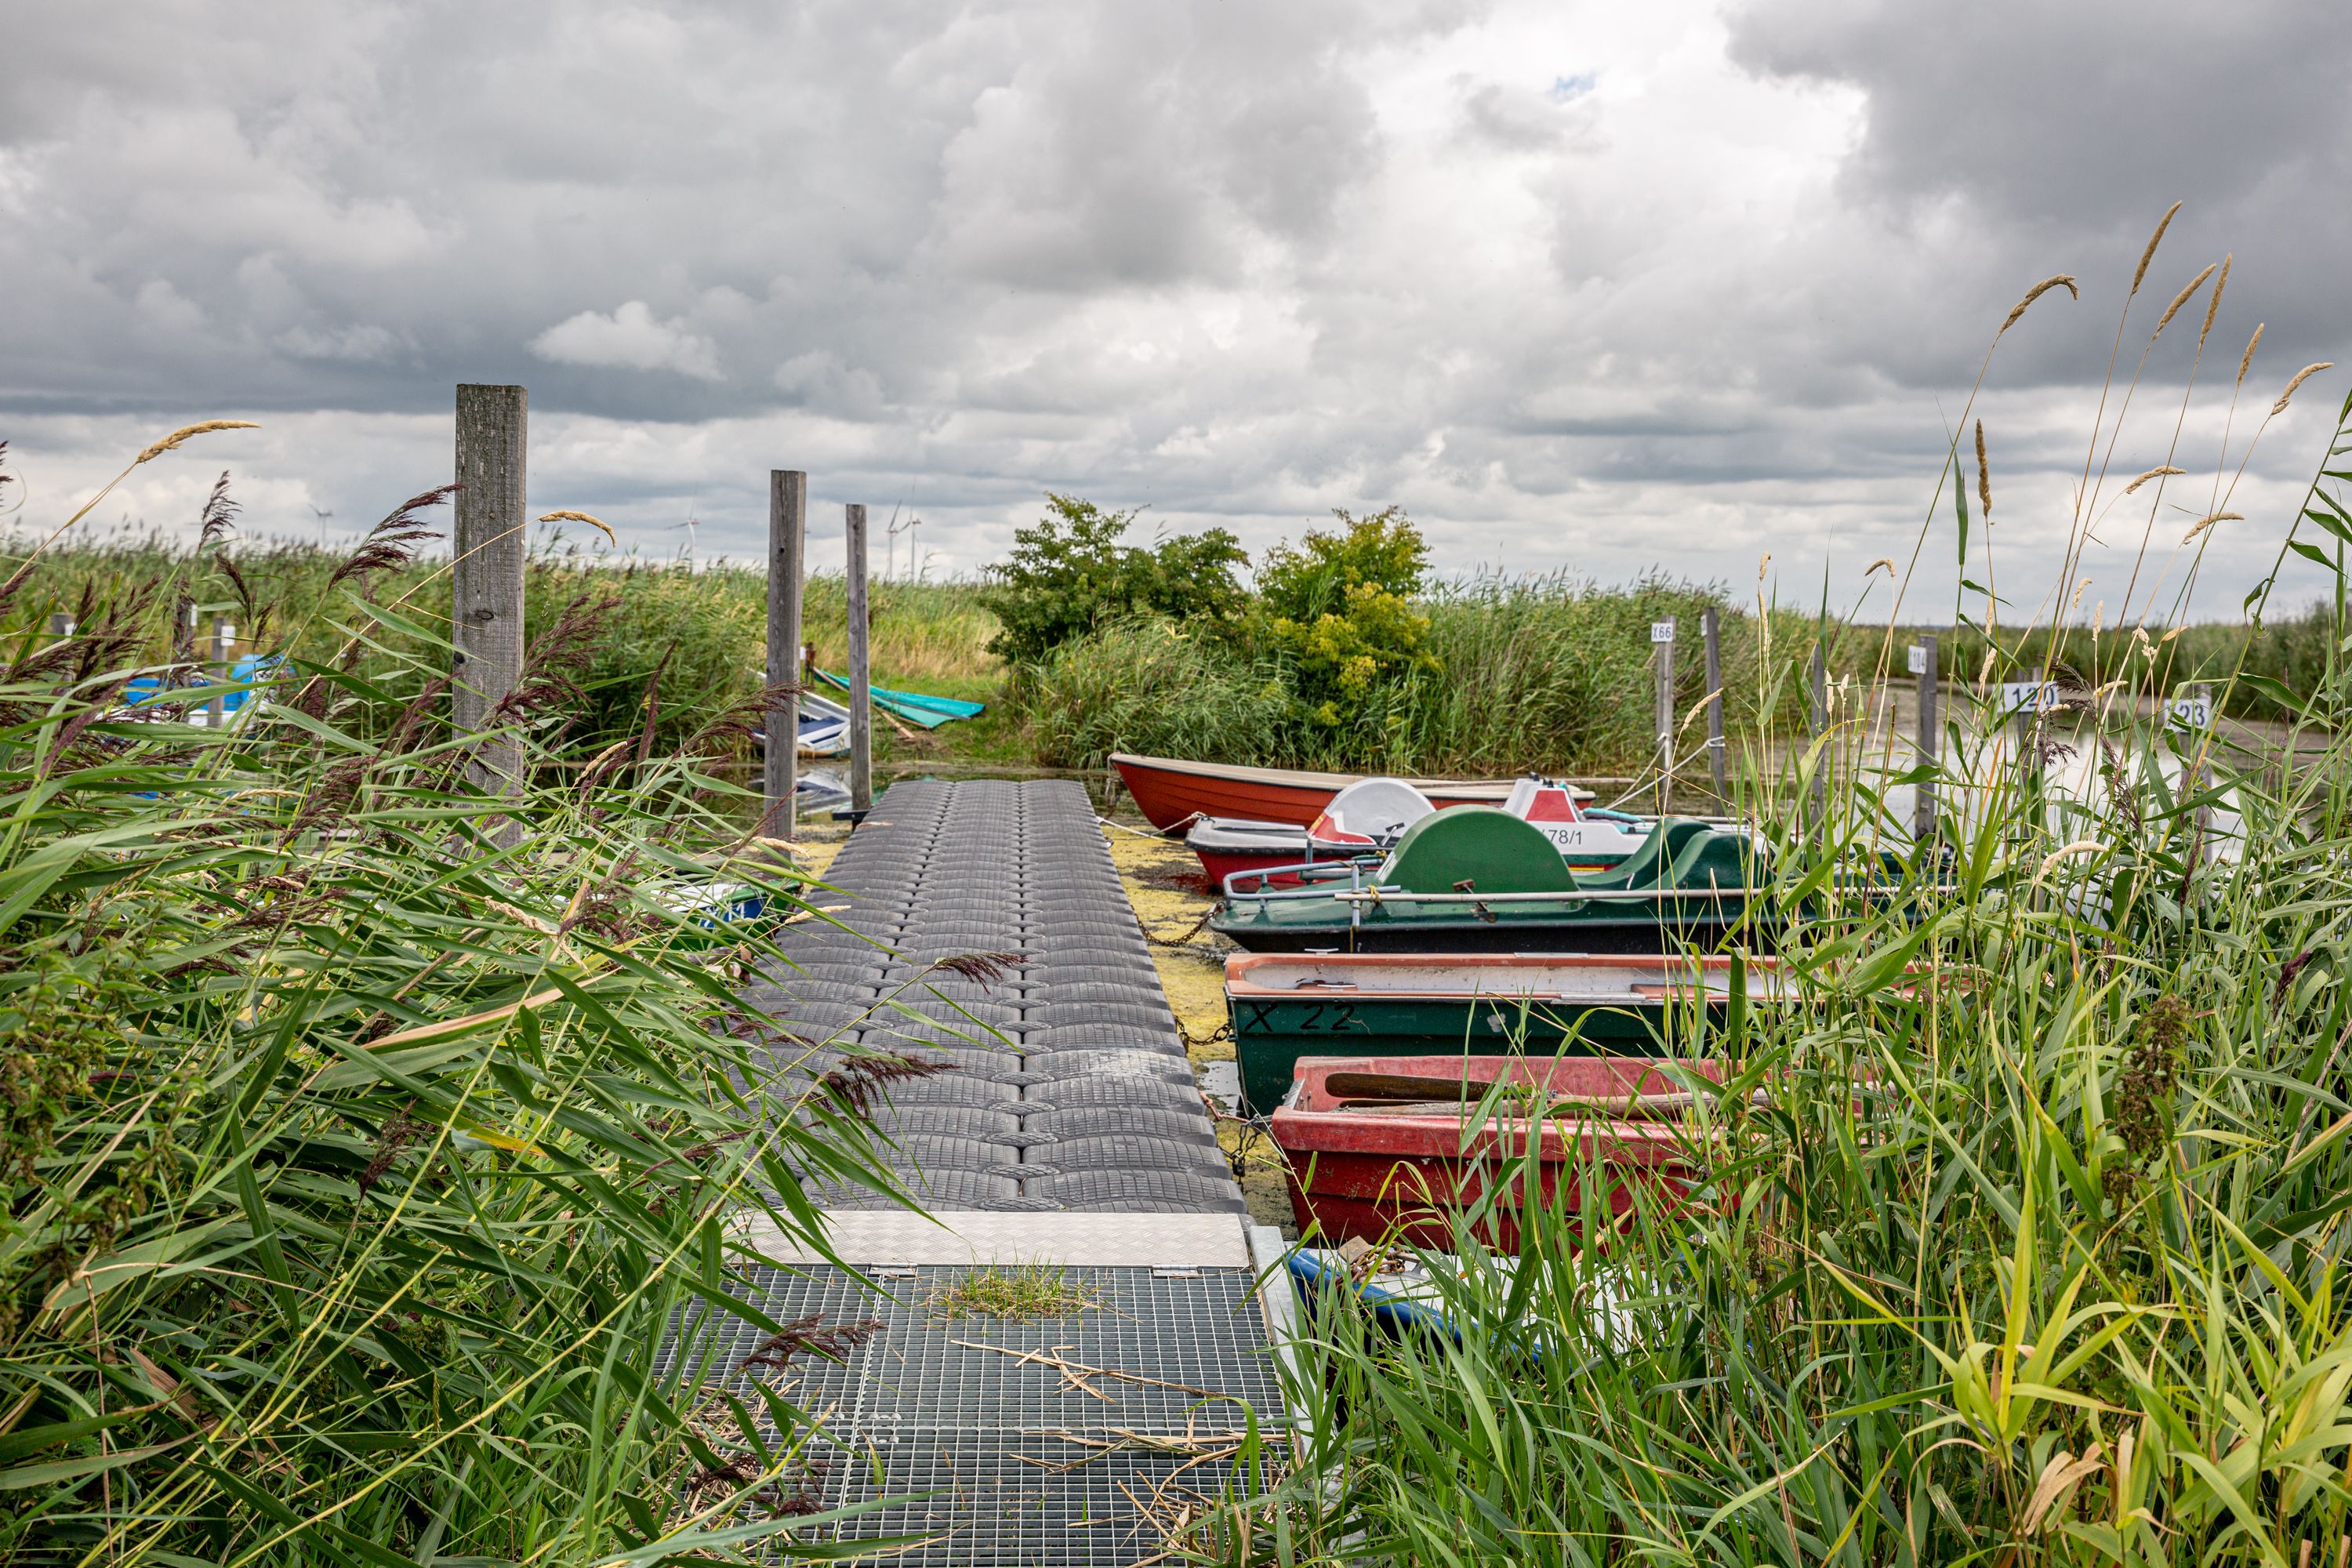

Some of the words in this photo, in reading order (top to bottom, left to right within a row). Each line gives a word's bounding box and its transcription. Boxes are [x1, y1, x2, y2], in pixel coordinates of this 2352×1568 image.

[1653, 626, 1671, 639] X66
[1244, 1003, 1279, 1033] X
[1300, 1003, 1355, 1031] 22
